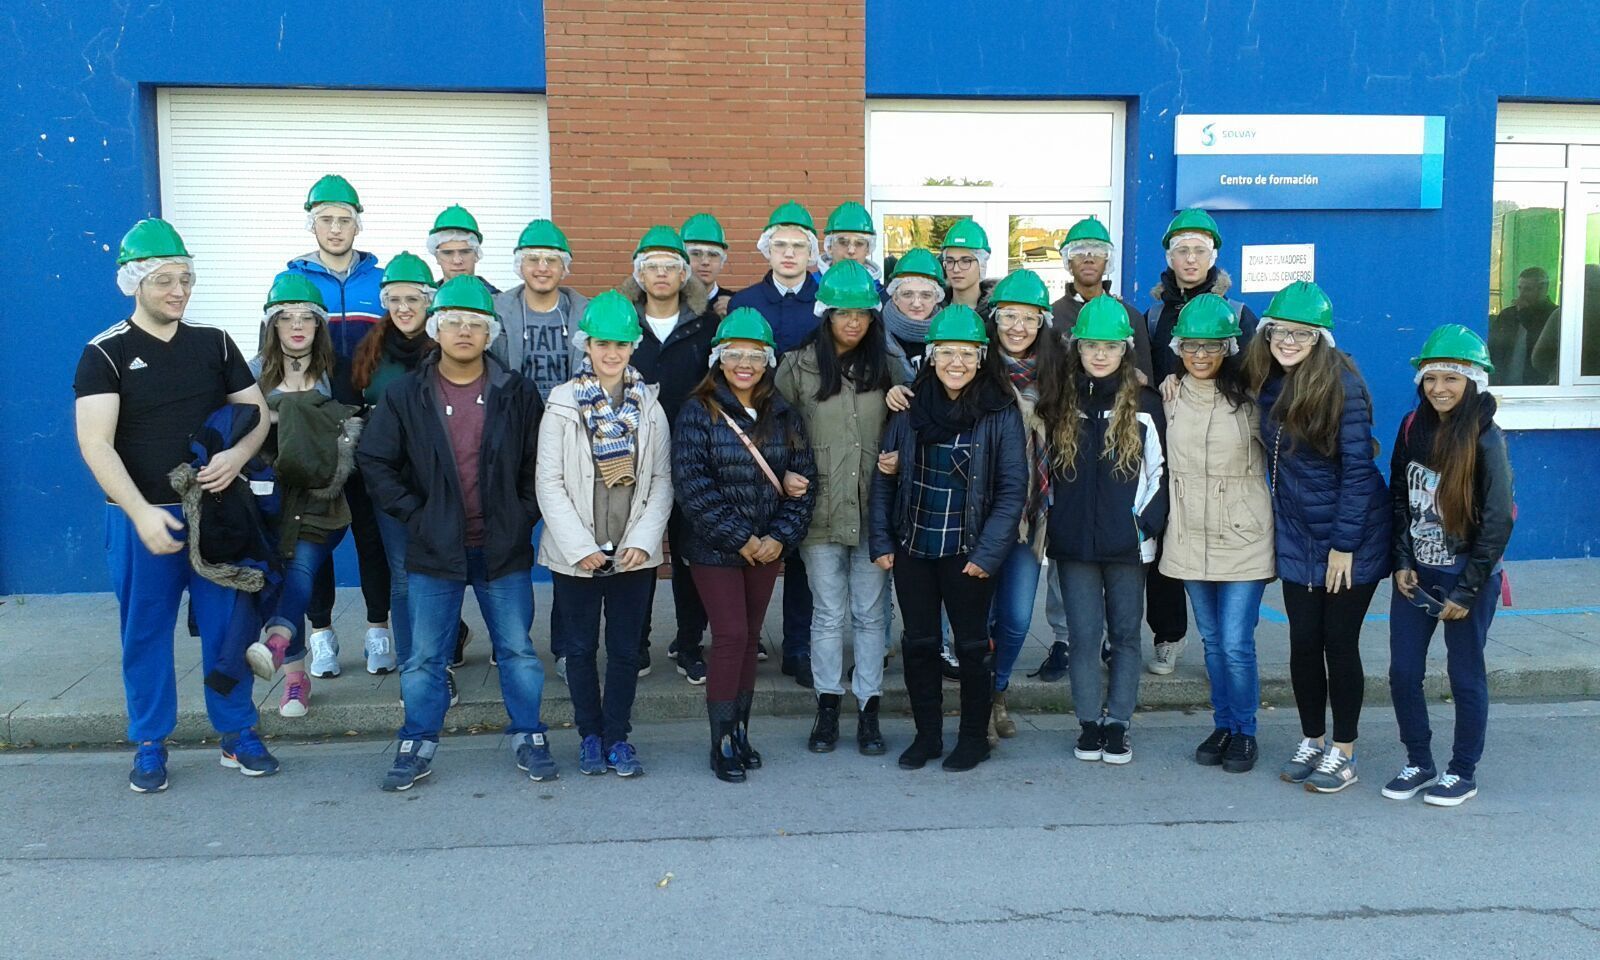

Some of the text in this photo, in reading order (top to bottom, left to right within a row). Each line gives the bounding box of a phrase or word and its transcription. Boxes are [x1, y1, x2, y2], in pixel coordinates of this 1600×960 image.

[1222, 130, 1256, 138] SOLVAY
[1220, 174, 1319, 185] Centro de formación
[1249, 254, 1307, 266] ZONA DE FUMADORES
[1269, 272, 1280, 281] LOS
[1281, 270, 1312, 281] CENICEROS
